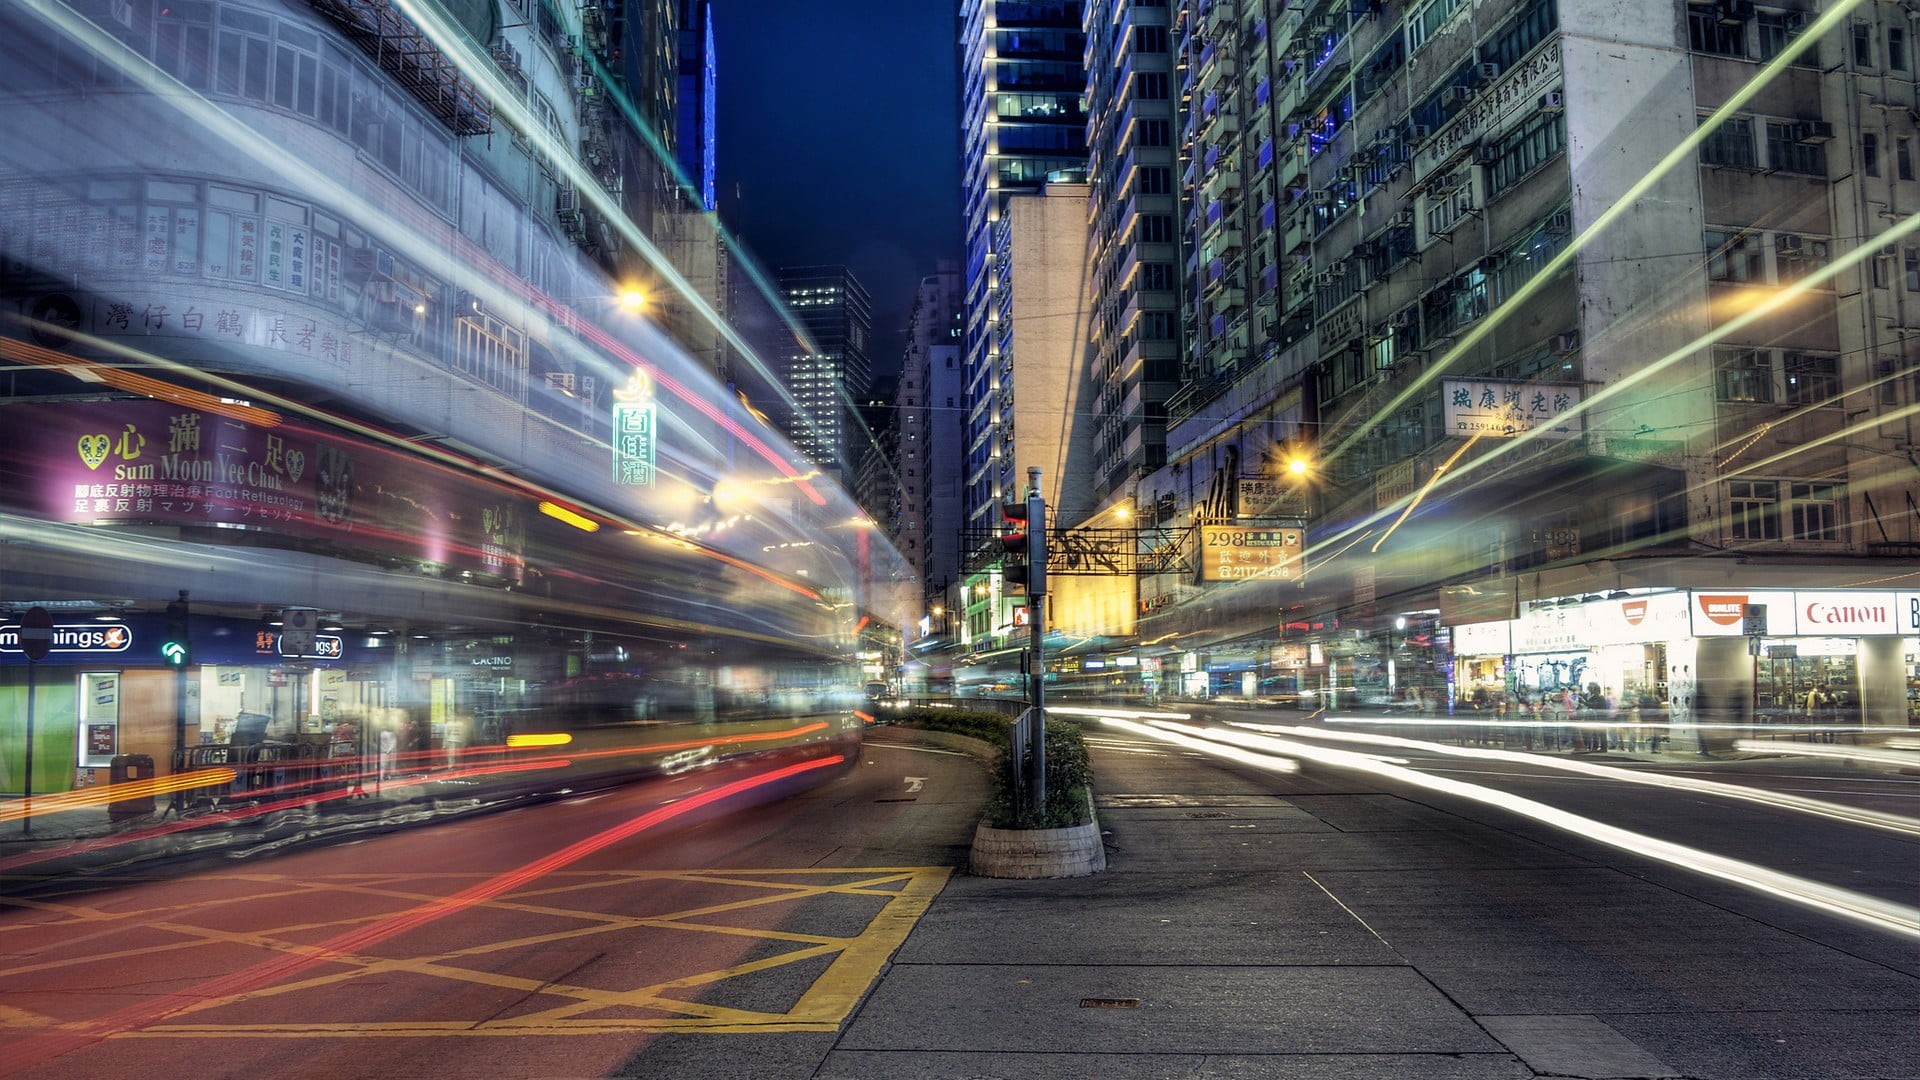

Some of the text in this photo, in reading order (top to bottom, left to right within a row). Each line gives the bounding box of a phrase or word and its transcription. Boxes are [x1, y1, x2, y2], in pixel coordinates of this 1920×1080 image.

[268, 225, 282, 282] 改善民生
[105, 303, 244, 337] 灣仔白鶴
[1451, 387, 1572, 413] 瑞康護老院
[113, 413, 284, 474] 心滿二足
[114, 453, 283, 491] Sum Moon Yee Chuk
[205, 486, 238, 499] Foot
[242, 490, 304, 511] Reflexology
[1207, 532, 1244, 547] 298
[1806, 602, 1886, 624] Canon
